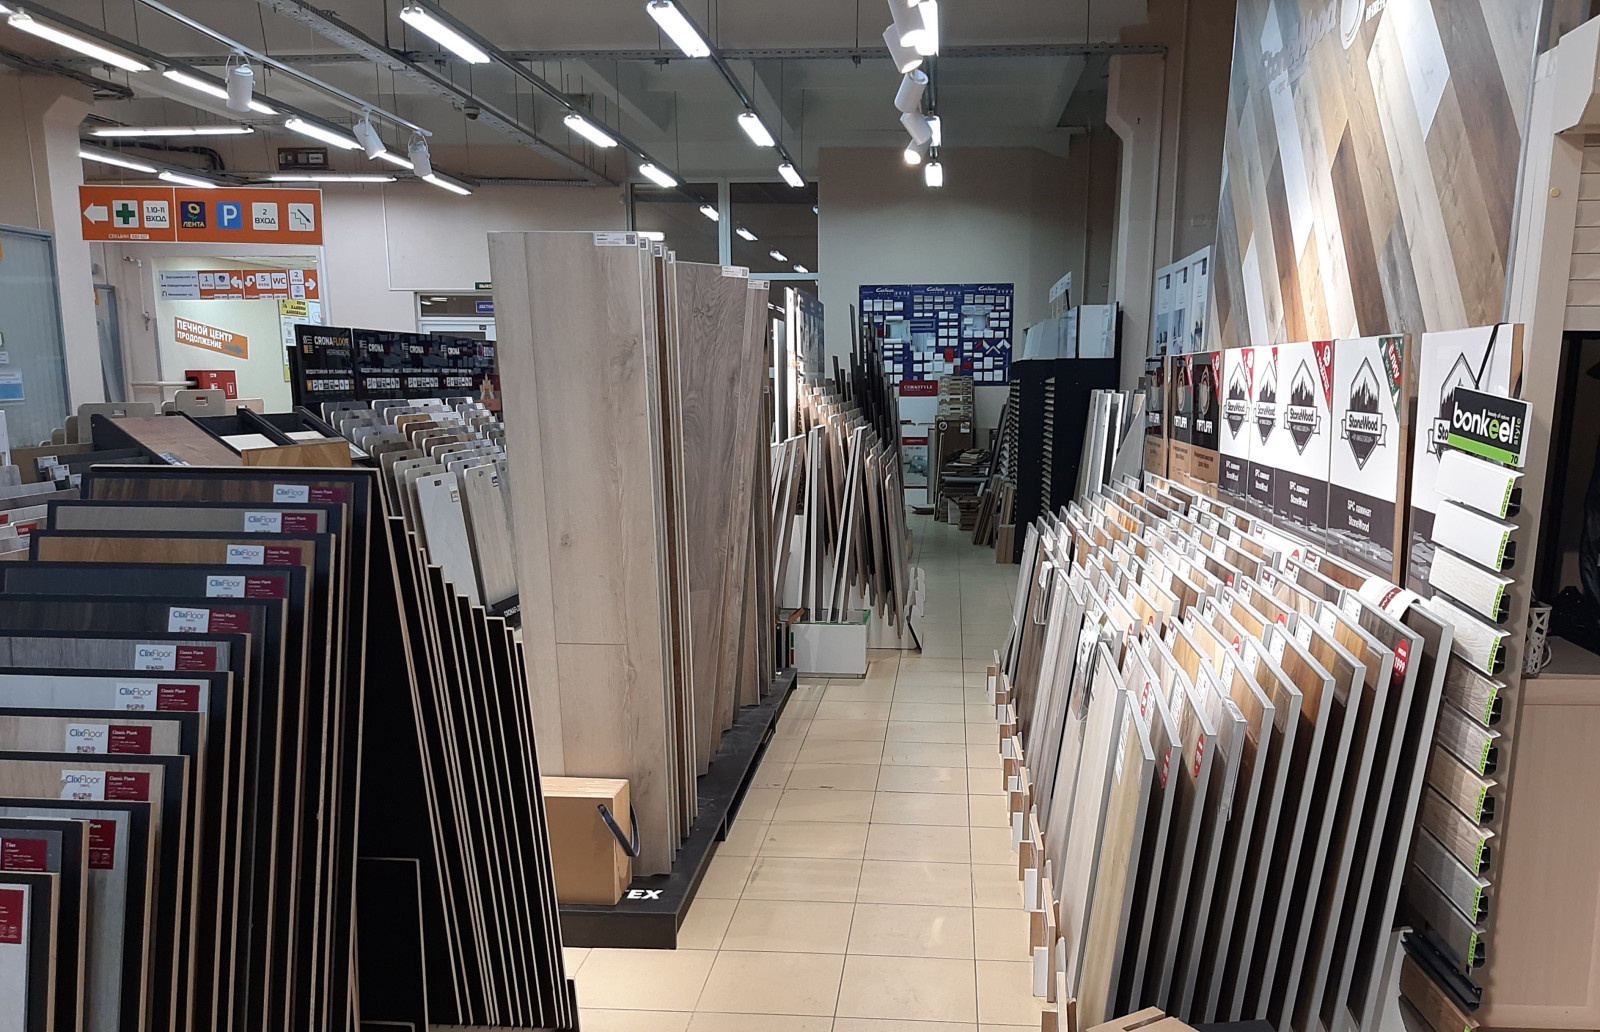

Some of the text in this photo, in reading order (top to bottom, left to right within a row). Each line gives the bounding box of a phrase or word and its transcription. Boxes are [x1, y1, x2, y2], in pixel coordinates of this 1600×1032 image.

[176, 319, 233, 343] ПЕЧНОЙ ЦЕНТР
[177, 330, 222, 350] ПРОДОЛЖЕНИЕ
[369, 343, 384, 352] CRONA
[409, 345, 424, 354] CRONA
[1388, 344, 1400, 379] ЁЛКУ
[1228, 401, 1245, 413] StoneWood
[1290, 408, 1314, 422] StoneWood
[1348, 414, 1378, 432] StoneWood
[1453, 402, 1515, 444] bonkeel
[1510, 455, 1518, 464] 70
[276, 488, 305, 496] ClixFloor
[248, 515, 278, 523] ClixFloor
[1349, 515, 1370, 533] StoneWood
[229, 548, 260, 557] ClixFloor
[210, 580, 242, 588] ClixFloor
[173, 610, 206, 619] ClixFloor
[139, 649, 172, 658] ClixFloor
[119, 687, 153, 696] ClixFloor
[69, 729, 104, 738] ClixFloor
[65, 774, 102, 784] ClixFloor
